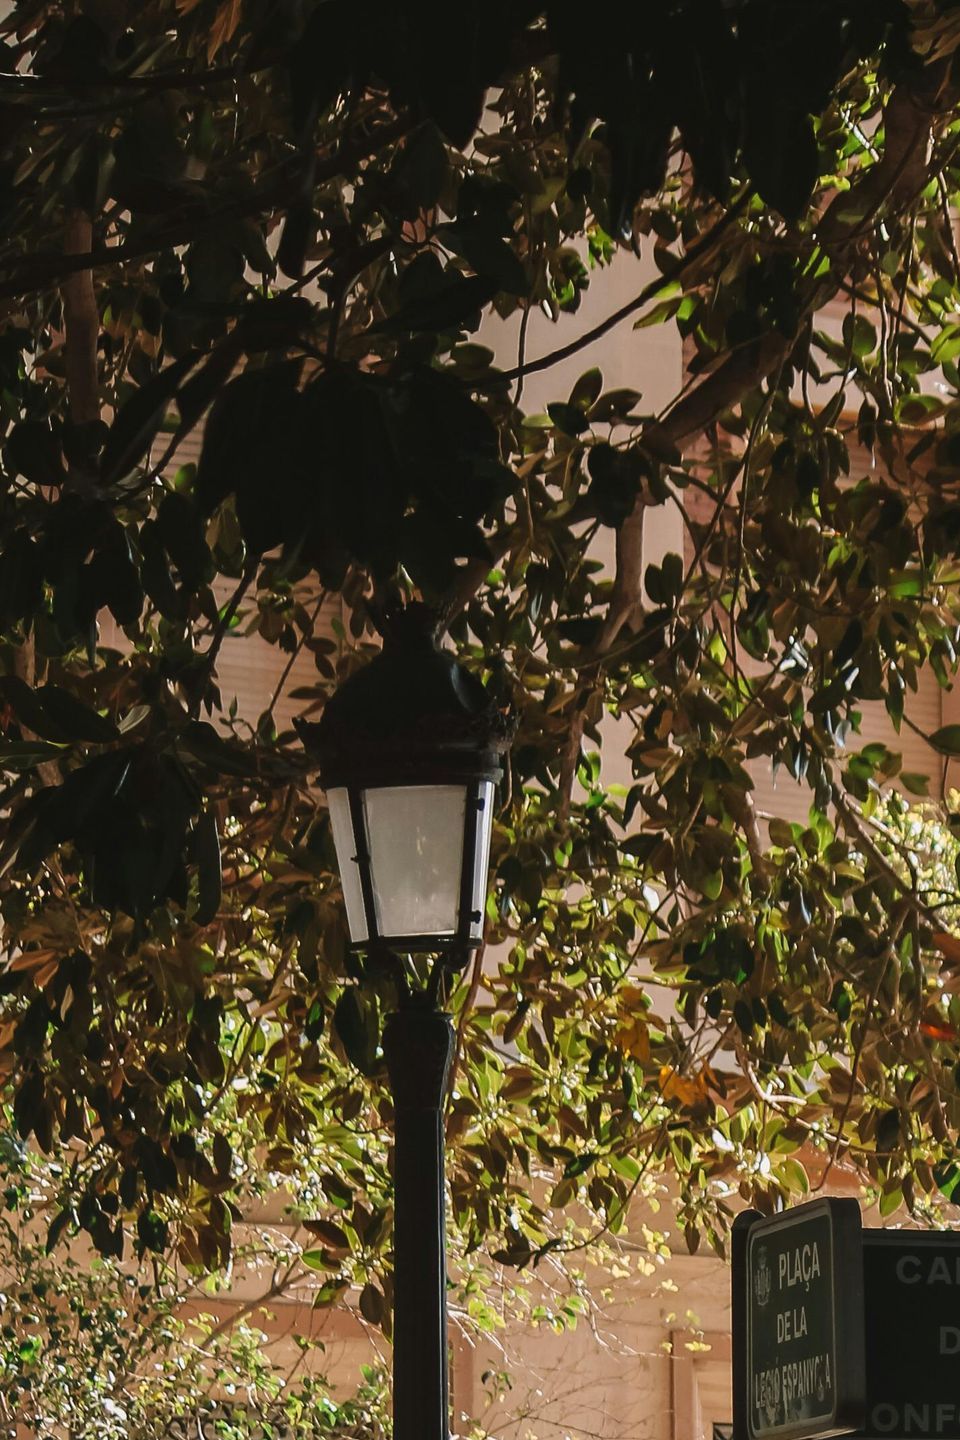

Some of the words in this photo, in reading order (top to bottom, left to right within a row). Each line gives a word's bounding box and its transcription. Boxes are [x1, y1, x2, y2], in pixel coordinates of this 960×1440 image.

[778, 1241, 821, 1292] PLAÇA
[776, 1310, 791, 1344] DE
[793, 1306, 808, 1339] LA
